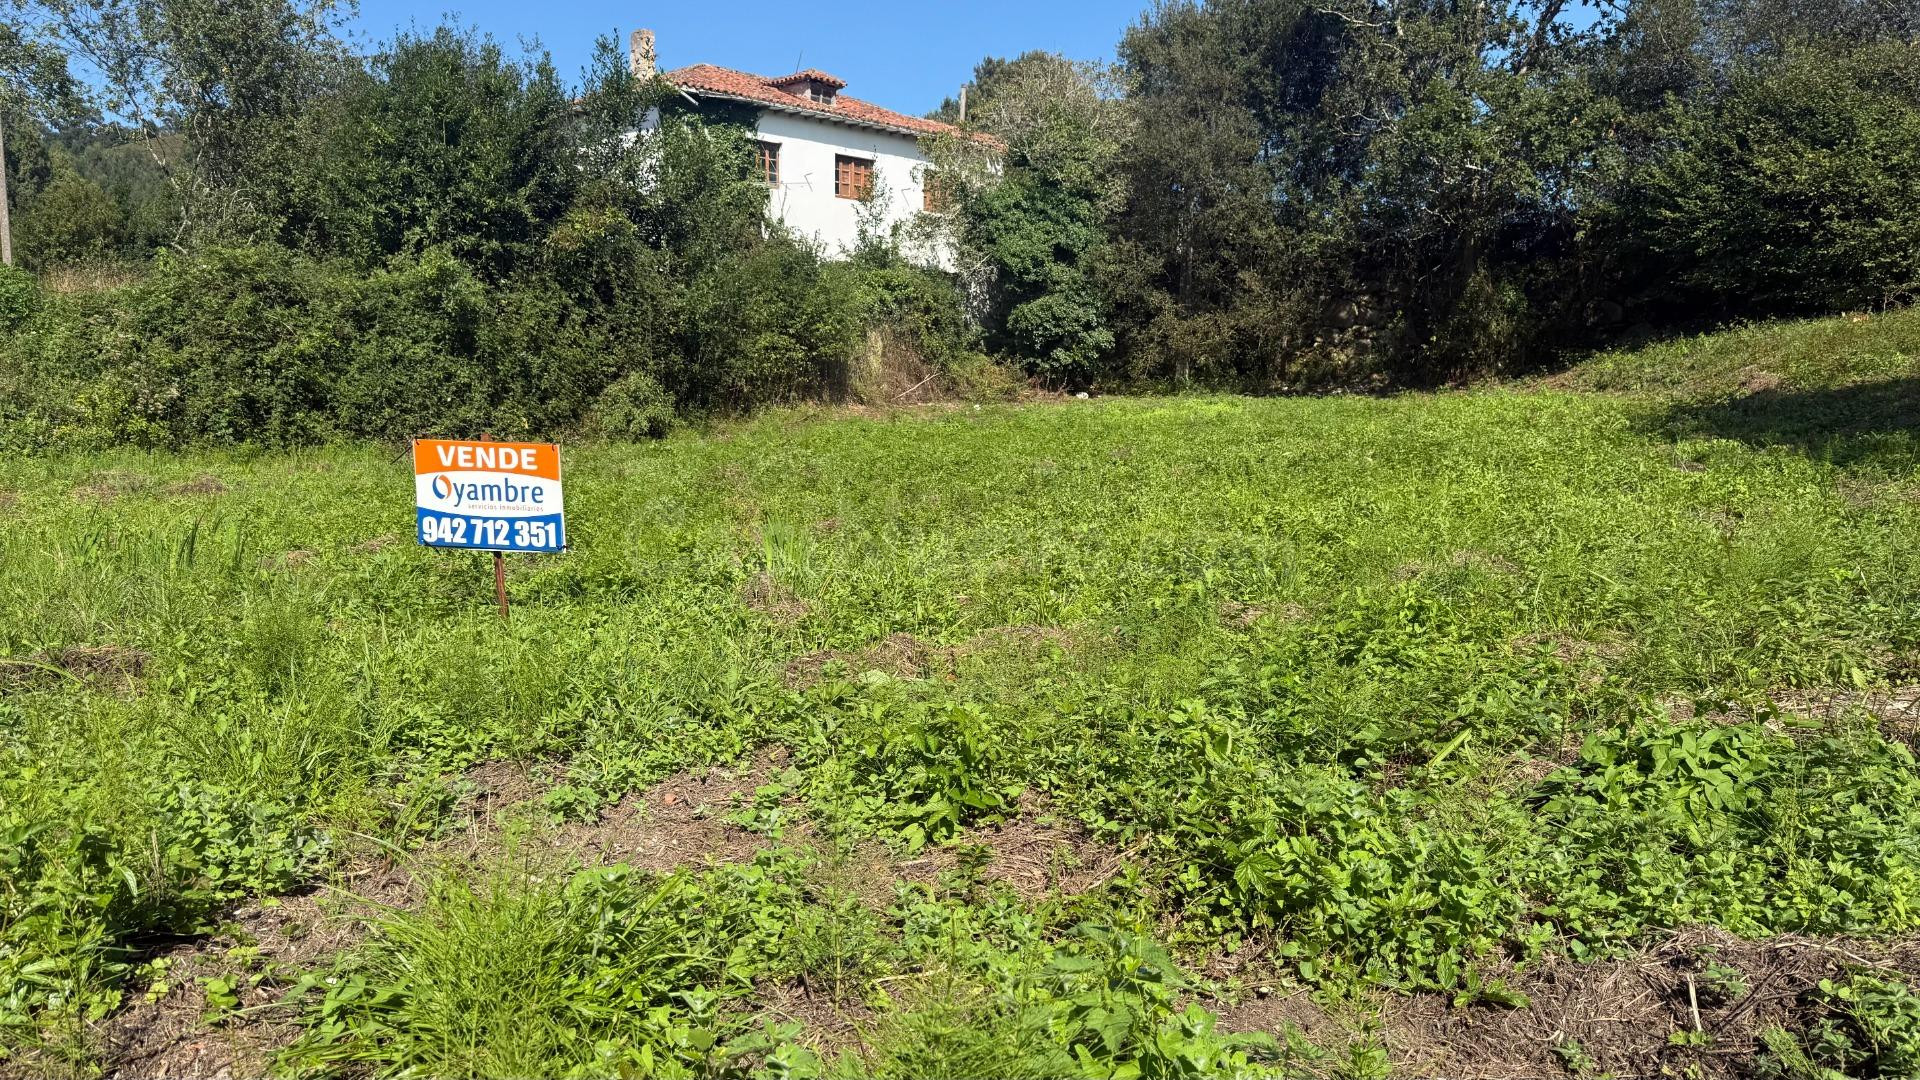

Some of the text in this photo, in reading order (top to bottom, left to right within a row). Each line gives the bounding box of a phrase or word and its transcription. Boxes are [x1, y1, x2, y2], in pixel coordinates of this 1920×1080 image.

[436, 445, 538, 470] VENDE
[432, 474, 544, 507] Oyambre
[422, 516, 557, 548] 942 712 351
